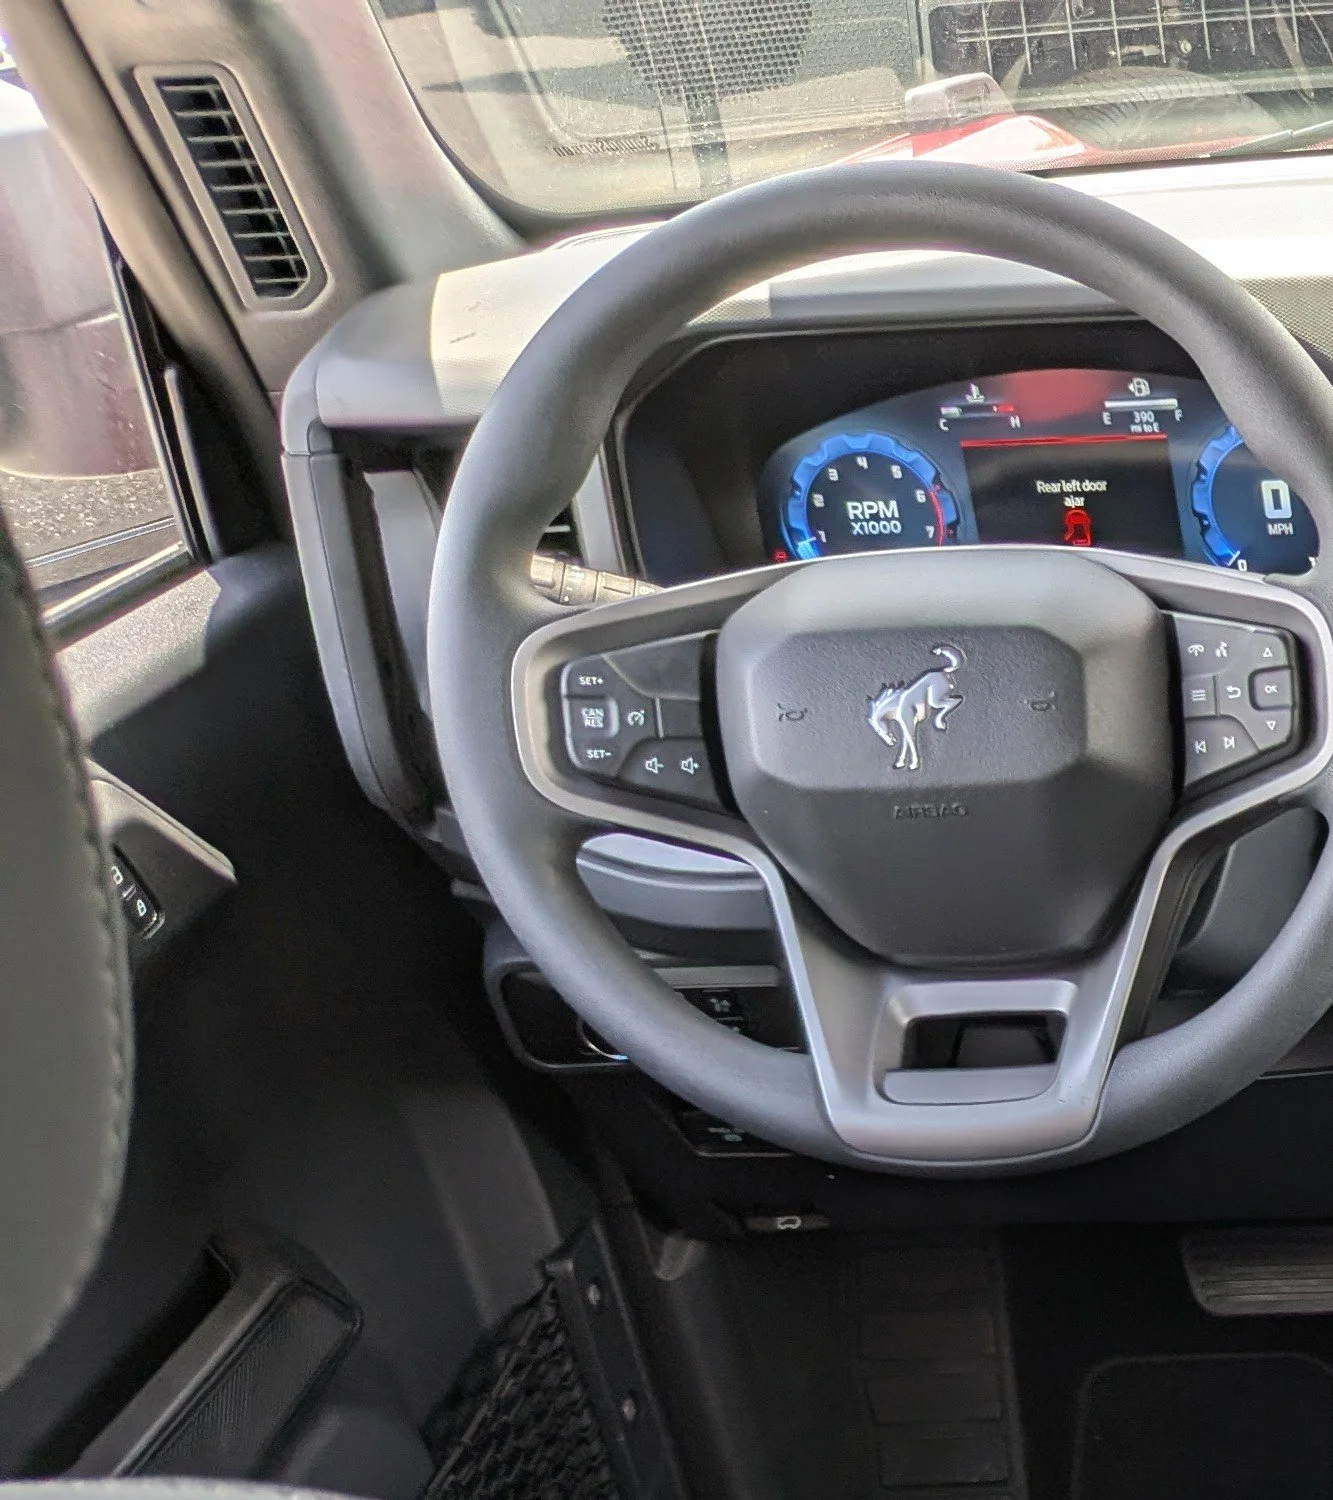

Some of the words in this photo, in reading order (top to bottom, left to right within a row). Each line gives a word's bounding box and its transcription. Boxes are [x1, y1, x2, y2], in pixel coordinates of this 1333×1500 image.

[1103, 412, 1112, 425] E
[1133, 411, 1155, 423] 390
[1175, 409, 1183, 421] F
[939, 419, 949, 431] C
[1010, 416, 1021, 428] H
[856, 457, 868, 470] 4
[828, 468, 839, 481] 3
[890, 465, 902, 479] 5
[1036, 481, 1061, 493] Rear
[1062, 480, 1081, 492] left
[1082, 480, 1107, 492] door
[813, 493, 825, 507] 2
[915, 490, 926, 503] 6
[1064, 495, 1085, 508] ajar
[1261, 480, 1292, 519] 0
[846, 500, 899, 520] RPM
[851, 521, 902, 536] X1000
[925, 526, 935, 539] 7
[1267, 523, 1293, 536] MPH
[818, 530, 828, 543] 1
[1237, 559, 1247, 571] 0
[1265, 685, 1278, 694] OK
[582, 708, 604, 717] CAN
[584, 719, 604, 728] RES
